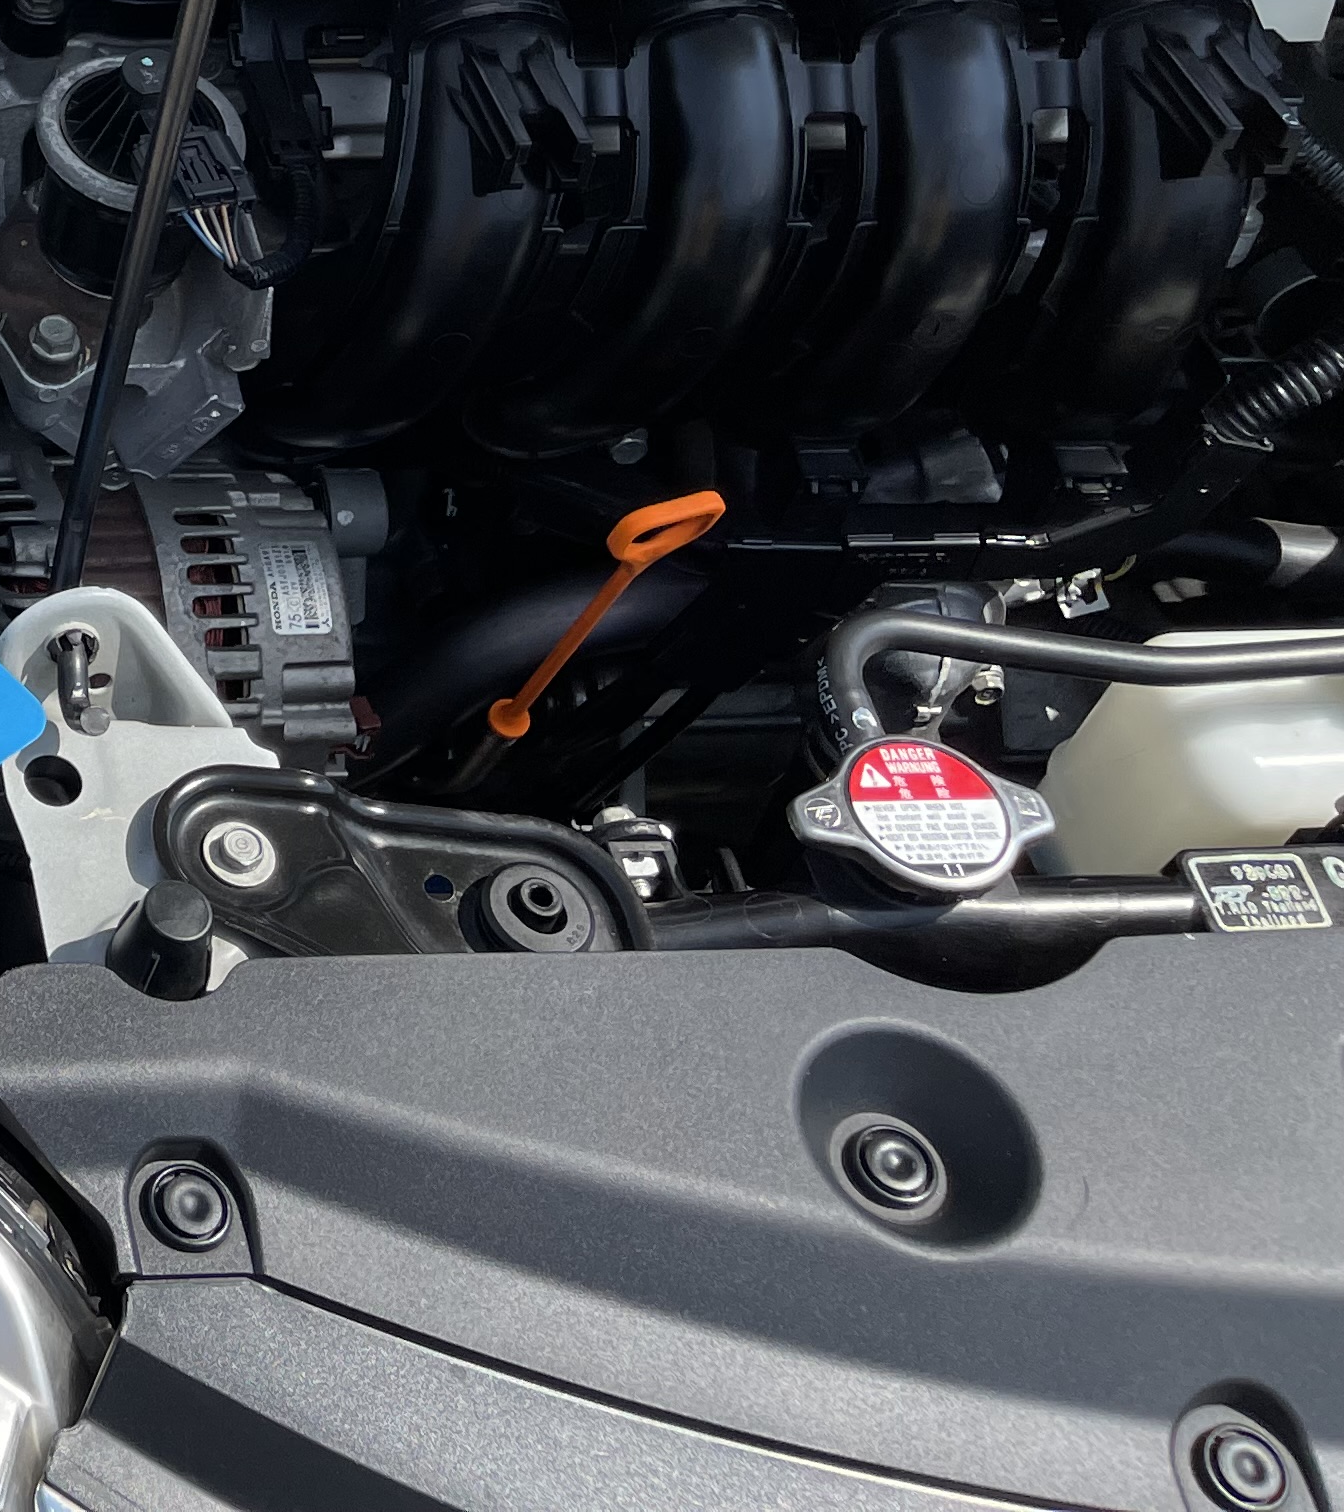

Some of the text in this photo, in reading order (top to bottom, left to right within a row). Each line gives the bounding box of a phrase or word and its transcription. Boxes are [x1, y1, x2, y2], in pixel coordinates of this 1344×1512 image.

[269, 581, 283, 630] HONDA
[879, 747, 937, 761] DANGER
[884, 761, 942, 775] WARNUNG
[942, 864, 965, 877] 1.1
